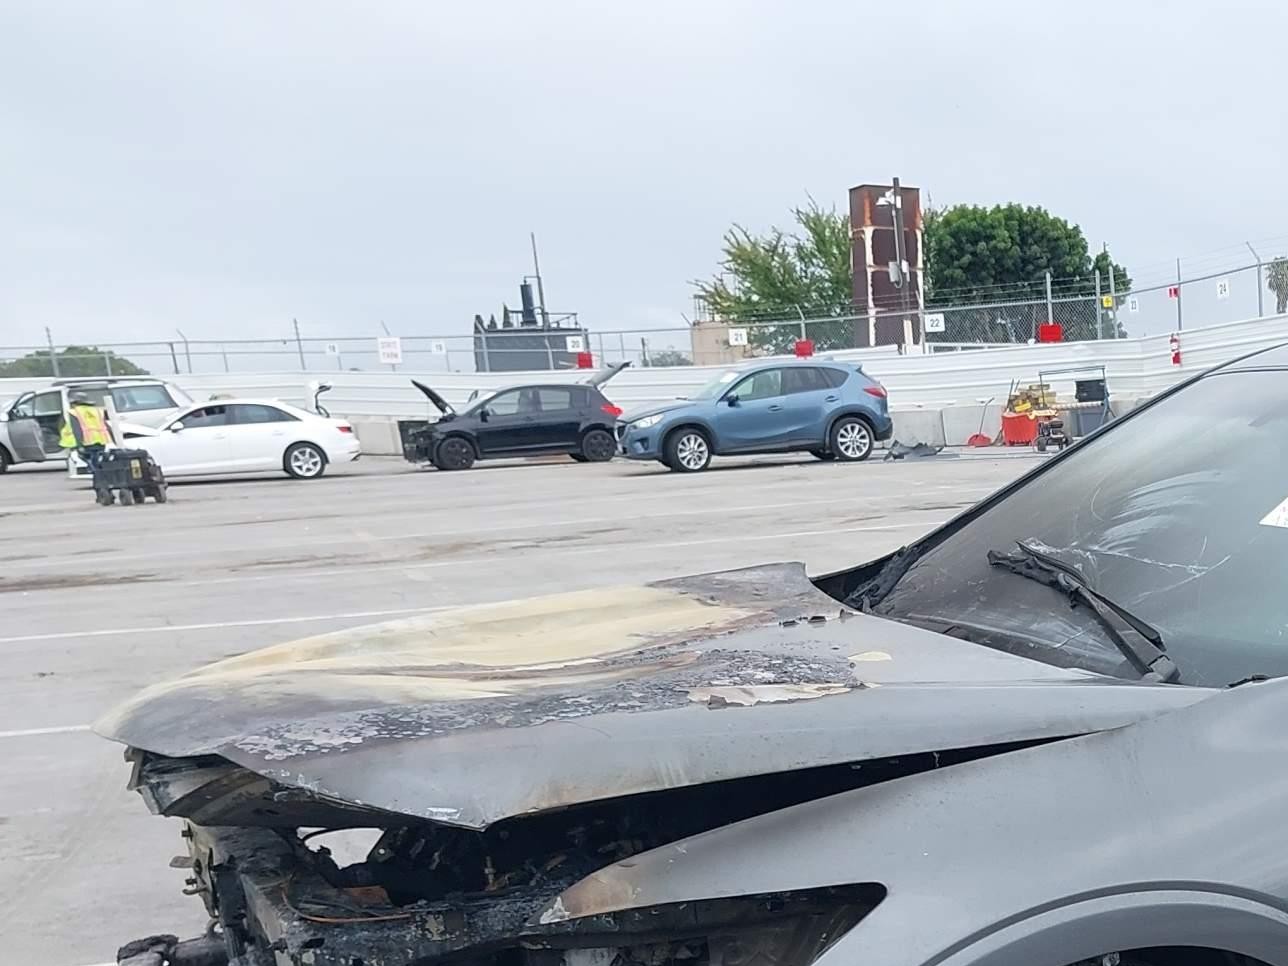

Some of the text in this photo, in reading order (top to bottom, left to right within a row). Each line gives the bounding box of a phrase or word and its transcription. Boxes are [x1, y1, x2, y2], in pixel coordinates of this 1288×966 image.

[1219, 284, 1227, 295] 24
[930, 319, 940, 327] 22
[733, 333, 743, 342] 21
[570, 340, 580, 348] 20
